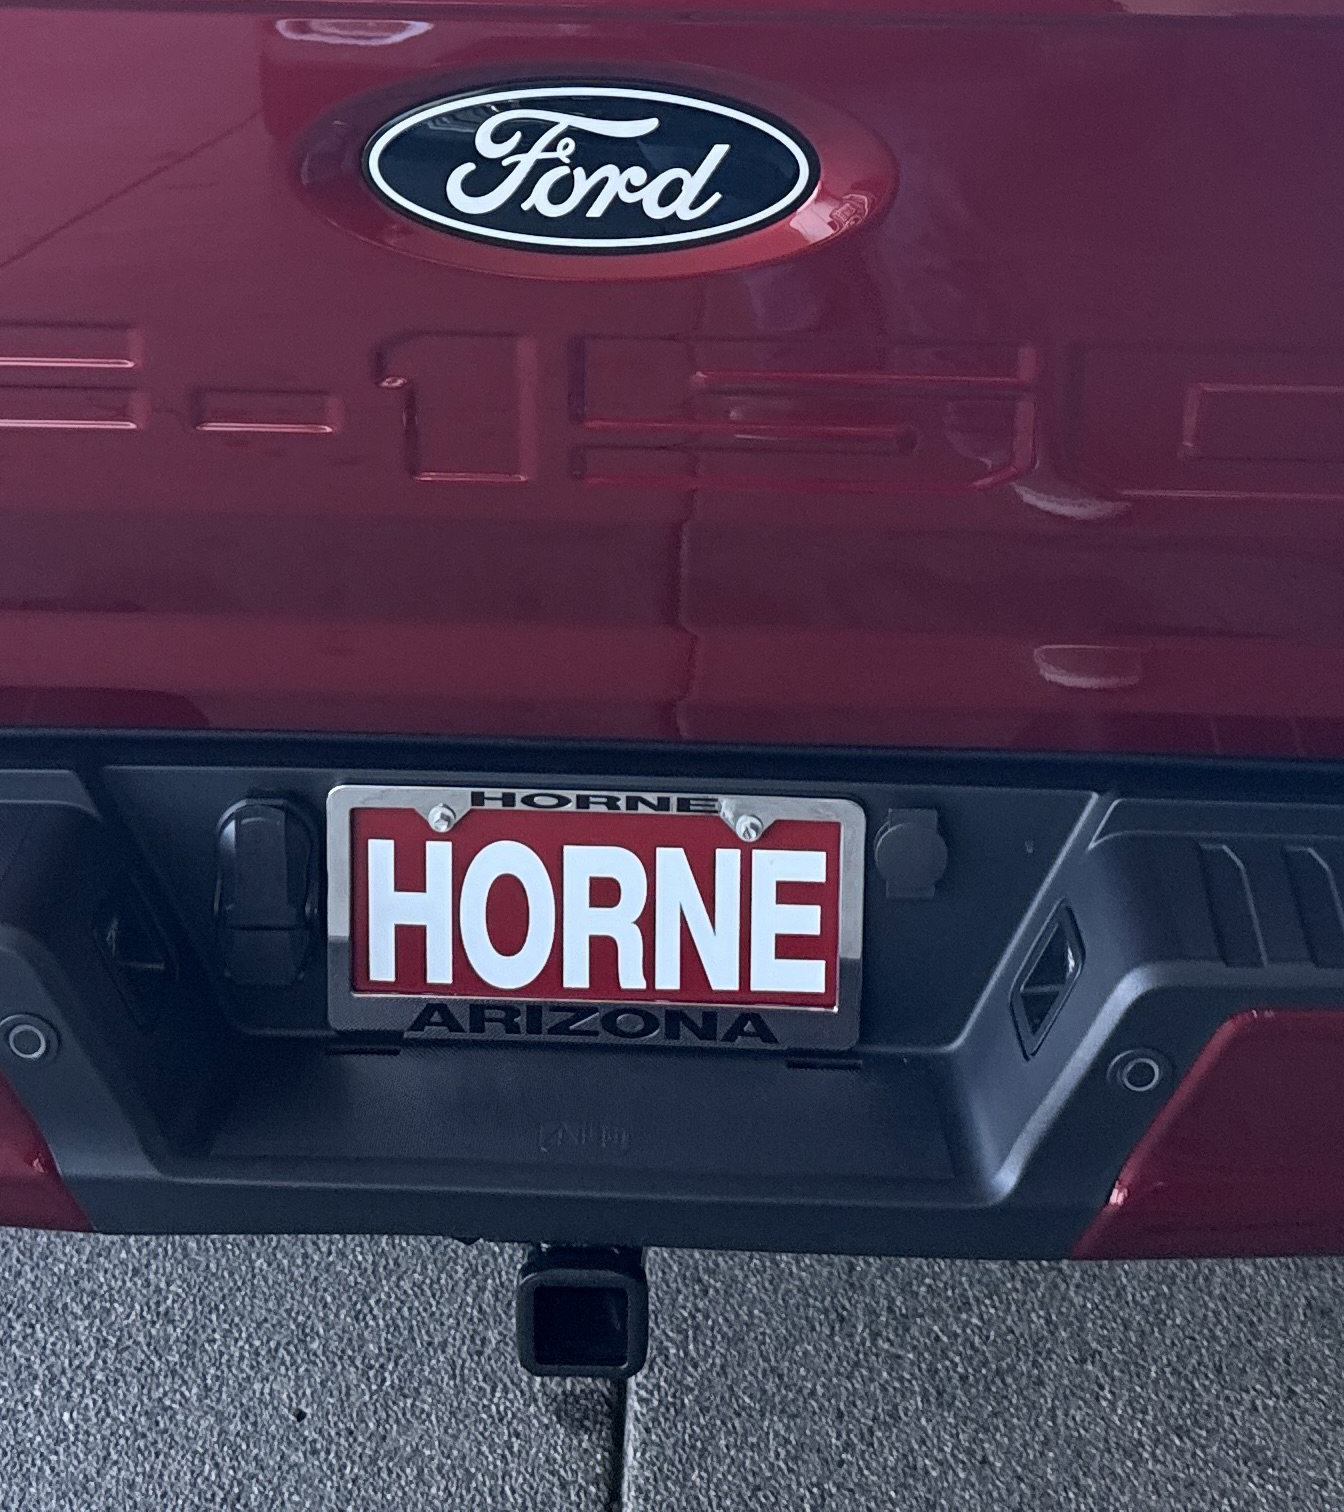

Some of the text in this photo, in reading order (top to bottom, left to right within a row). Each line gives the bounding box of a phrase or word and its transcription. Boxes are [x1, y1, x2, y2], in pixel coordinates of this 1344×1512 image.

[446, 108, 730, 221] Ford
[470, 790, 721, 815] HORNE
[367, 837, 827, 993] HORNE
[408, 1002, 780, 1045] ARIZONA
